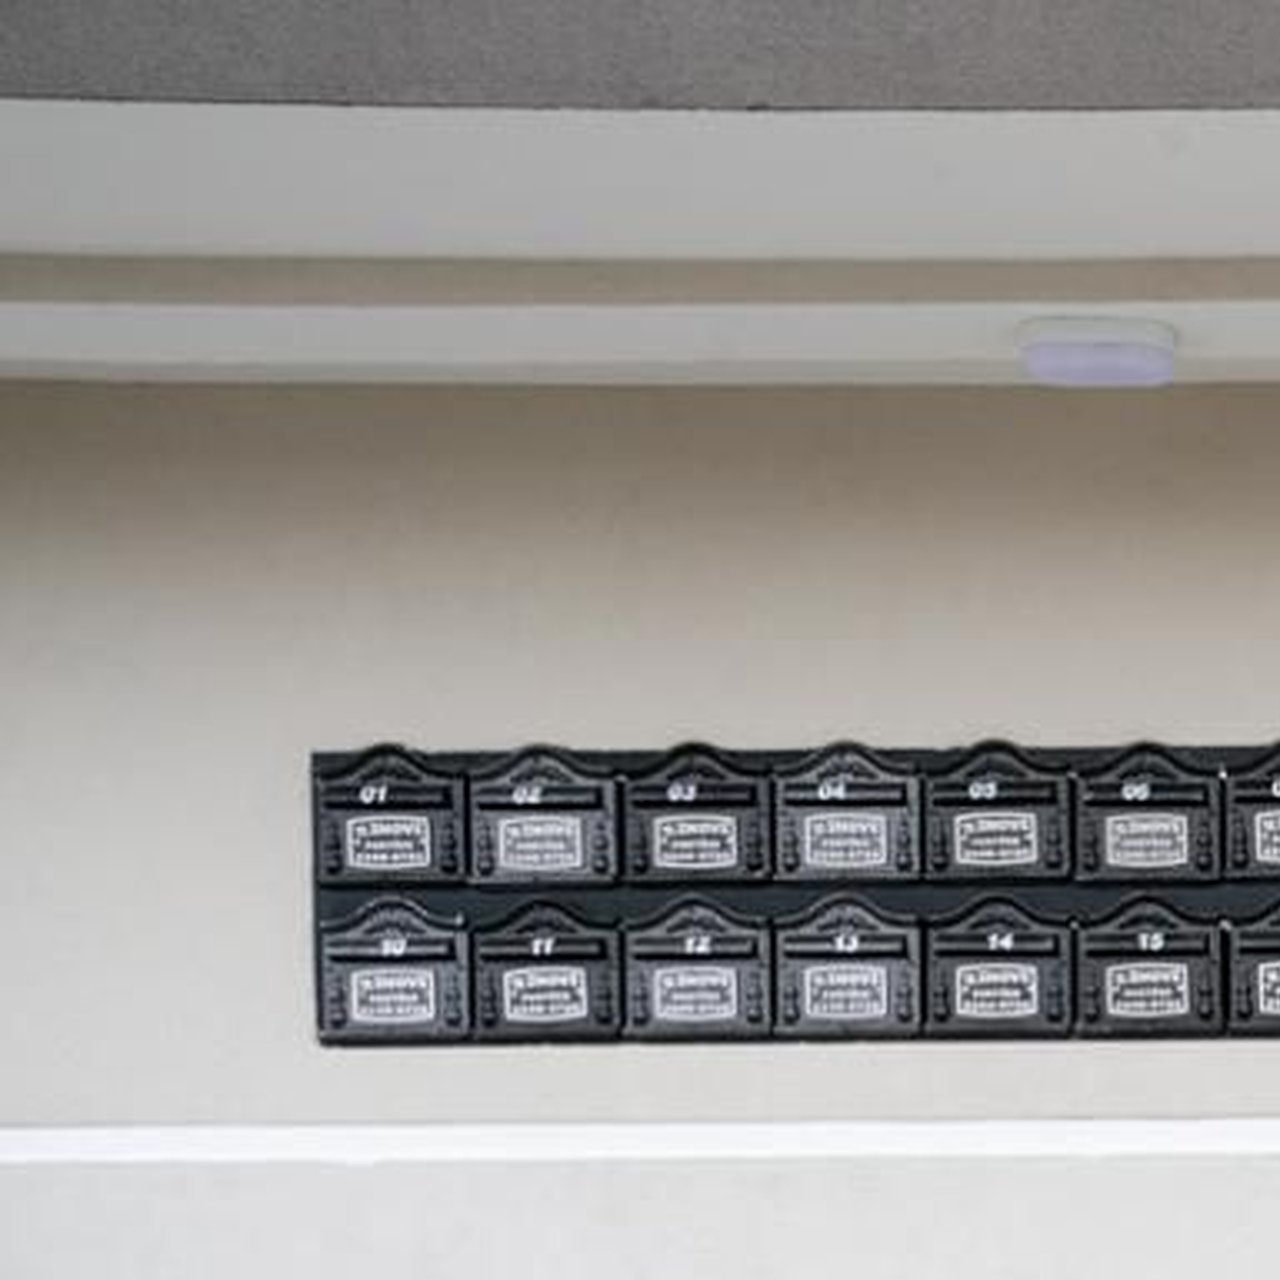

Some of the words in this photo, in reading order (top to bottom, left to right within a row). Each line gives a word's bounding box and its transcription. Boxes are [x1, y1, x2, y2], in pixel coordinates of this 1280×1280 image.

[359, 785, 387, 804] 01
[816, 780, 848, 800] 04
[532, 937, 554, 955] 11
[988, 933, 1014, 950] 14
